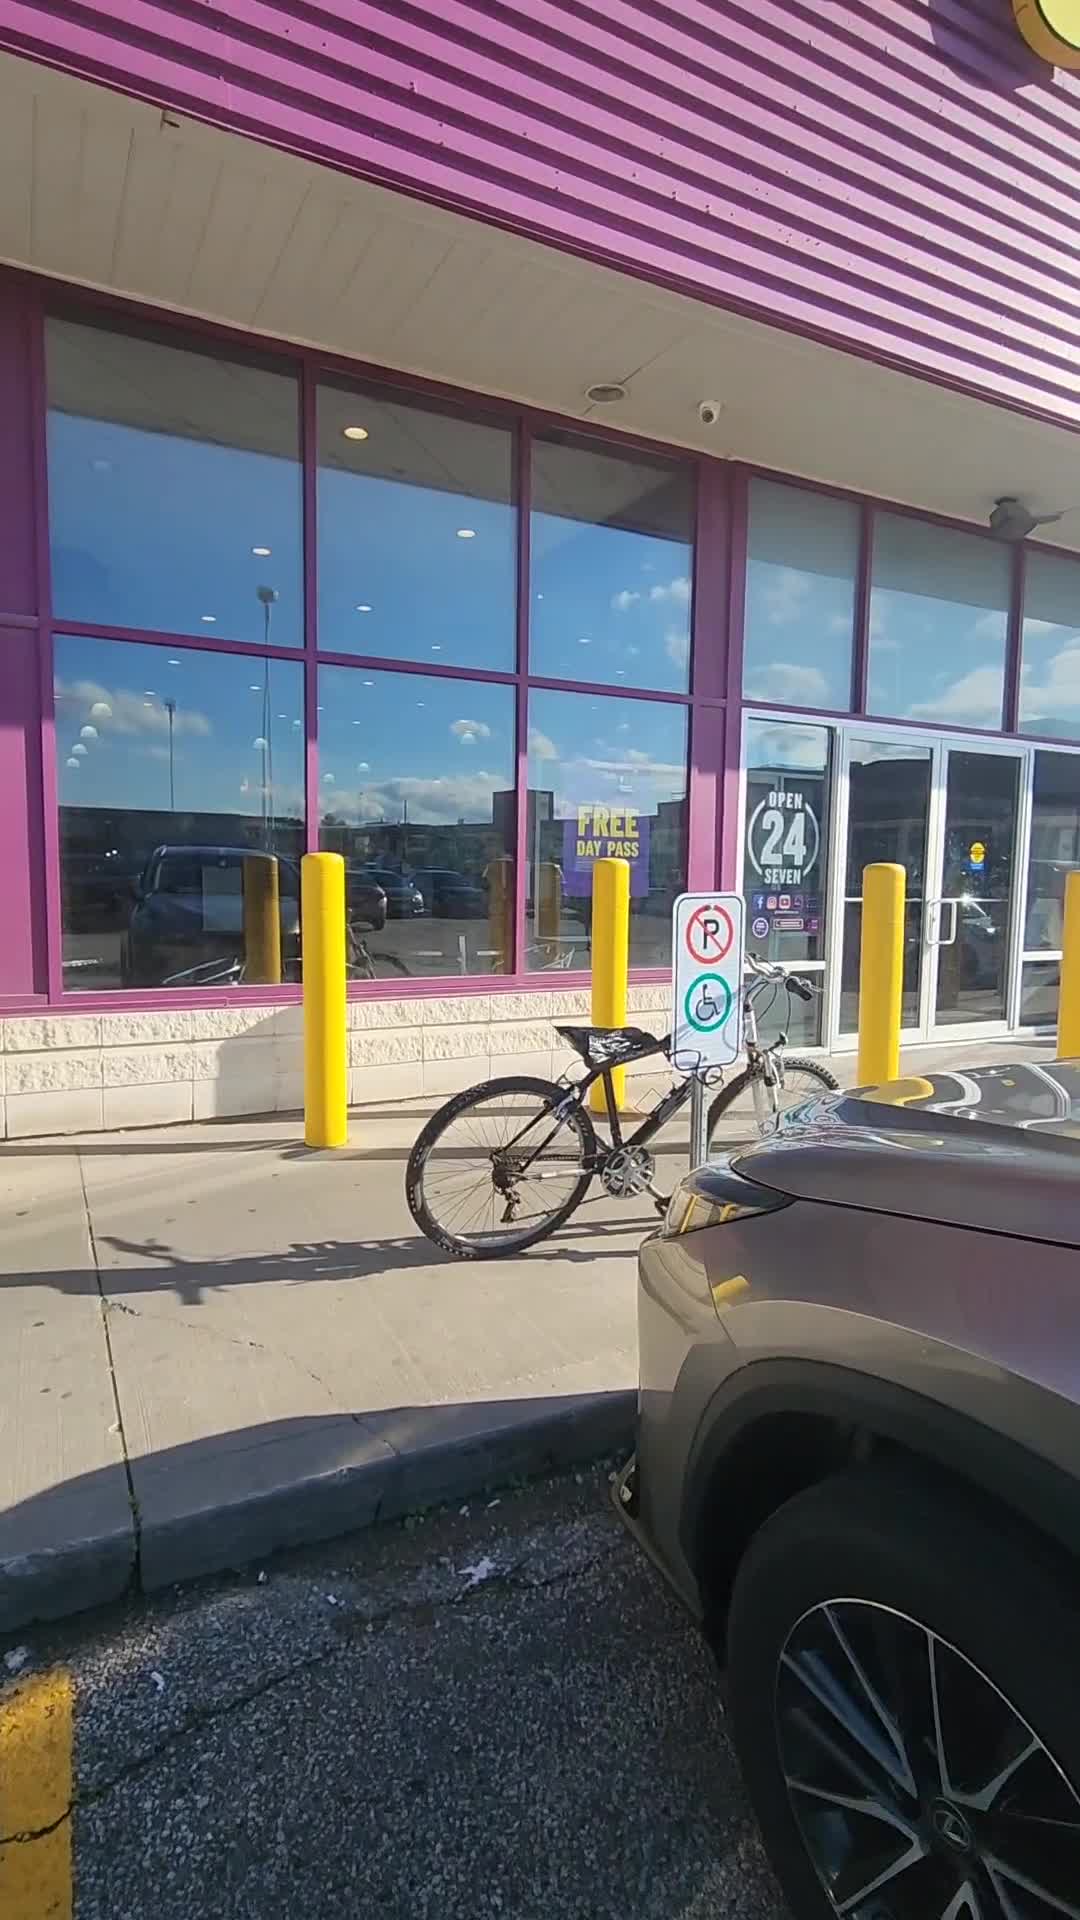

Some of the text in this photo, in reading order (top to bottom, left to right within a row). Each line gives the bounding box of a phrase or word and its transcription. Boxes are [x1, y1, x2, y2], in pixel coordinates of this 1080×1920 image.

[769, 791, 803, 809] OPEN
[577, 806, 640, 838] FREE
[576, 840, 639, 858] DAY PASS
[760, 809, 807, 866] 24
[764, 868, 801, 885] SEVEN
[703, 919, 720, 950] P
